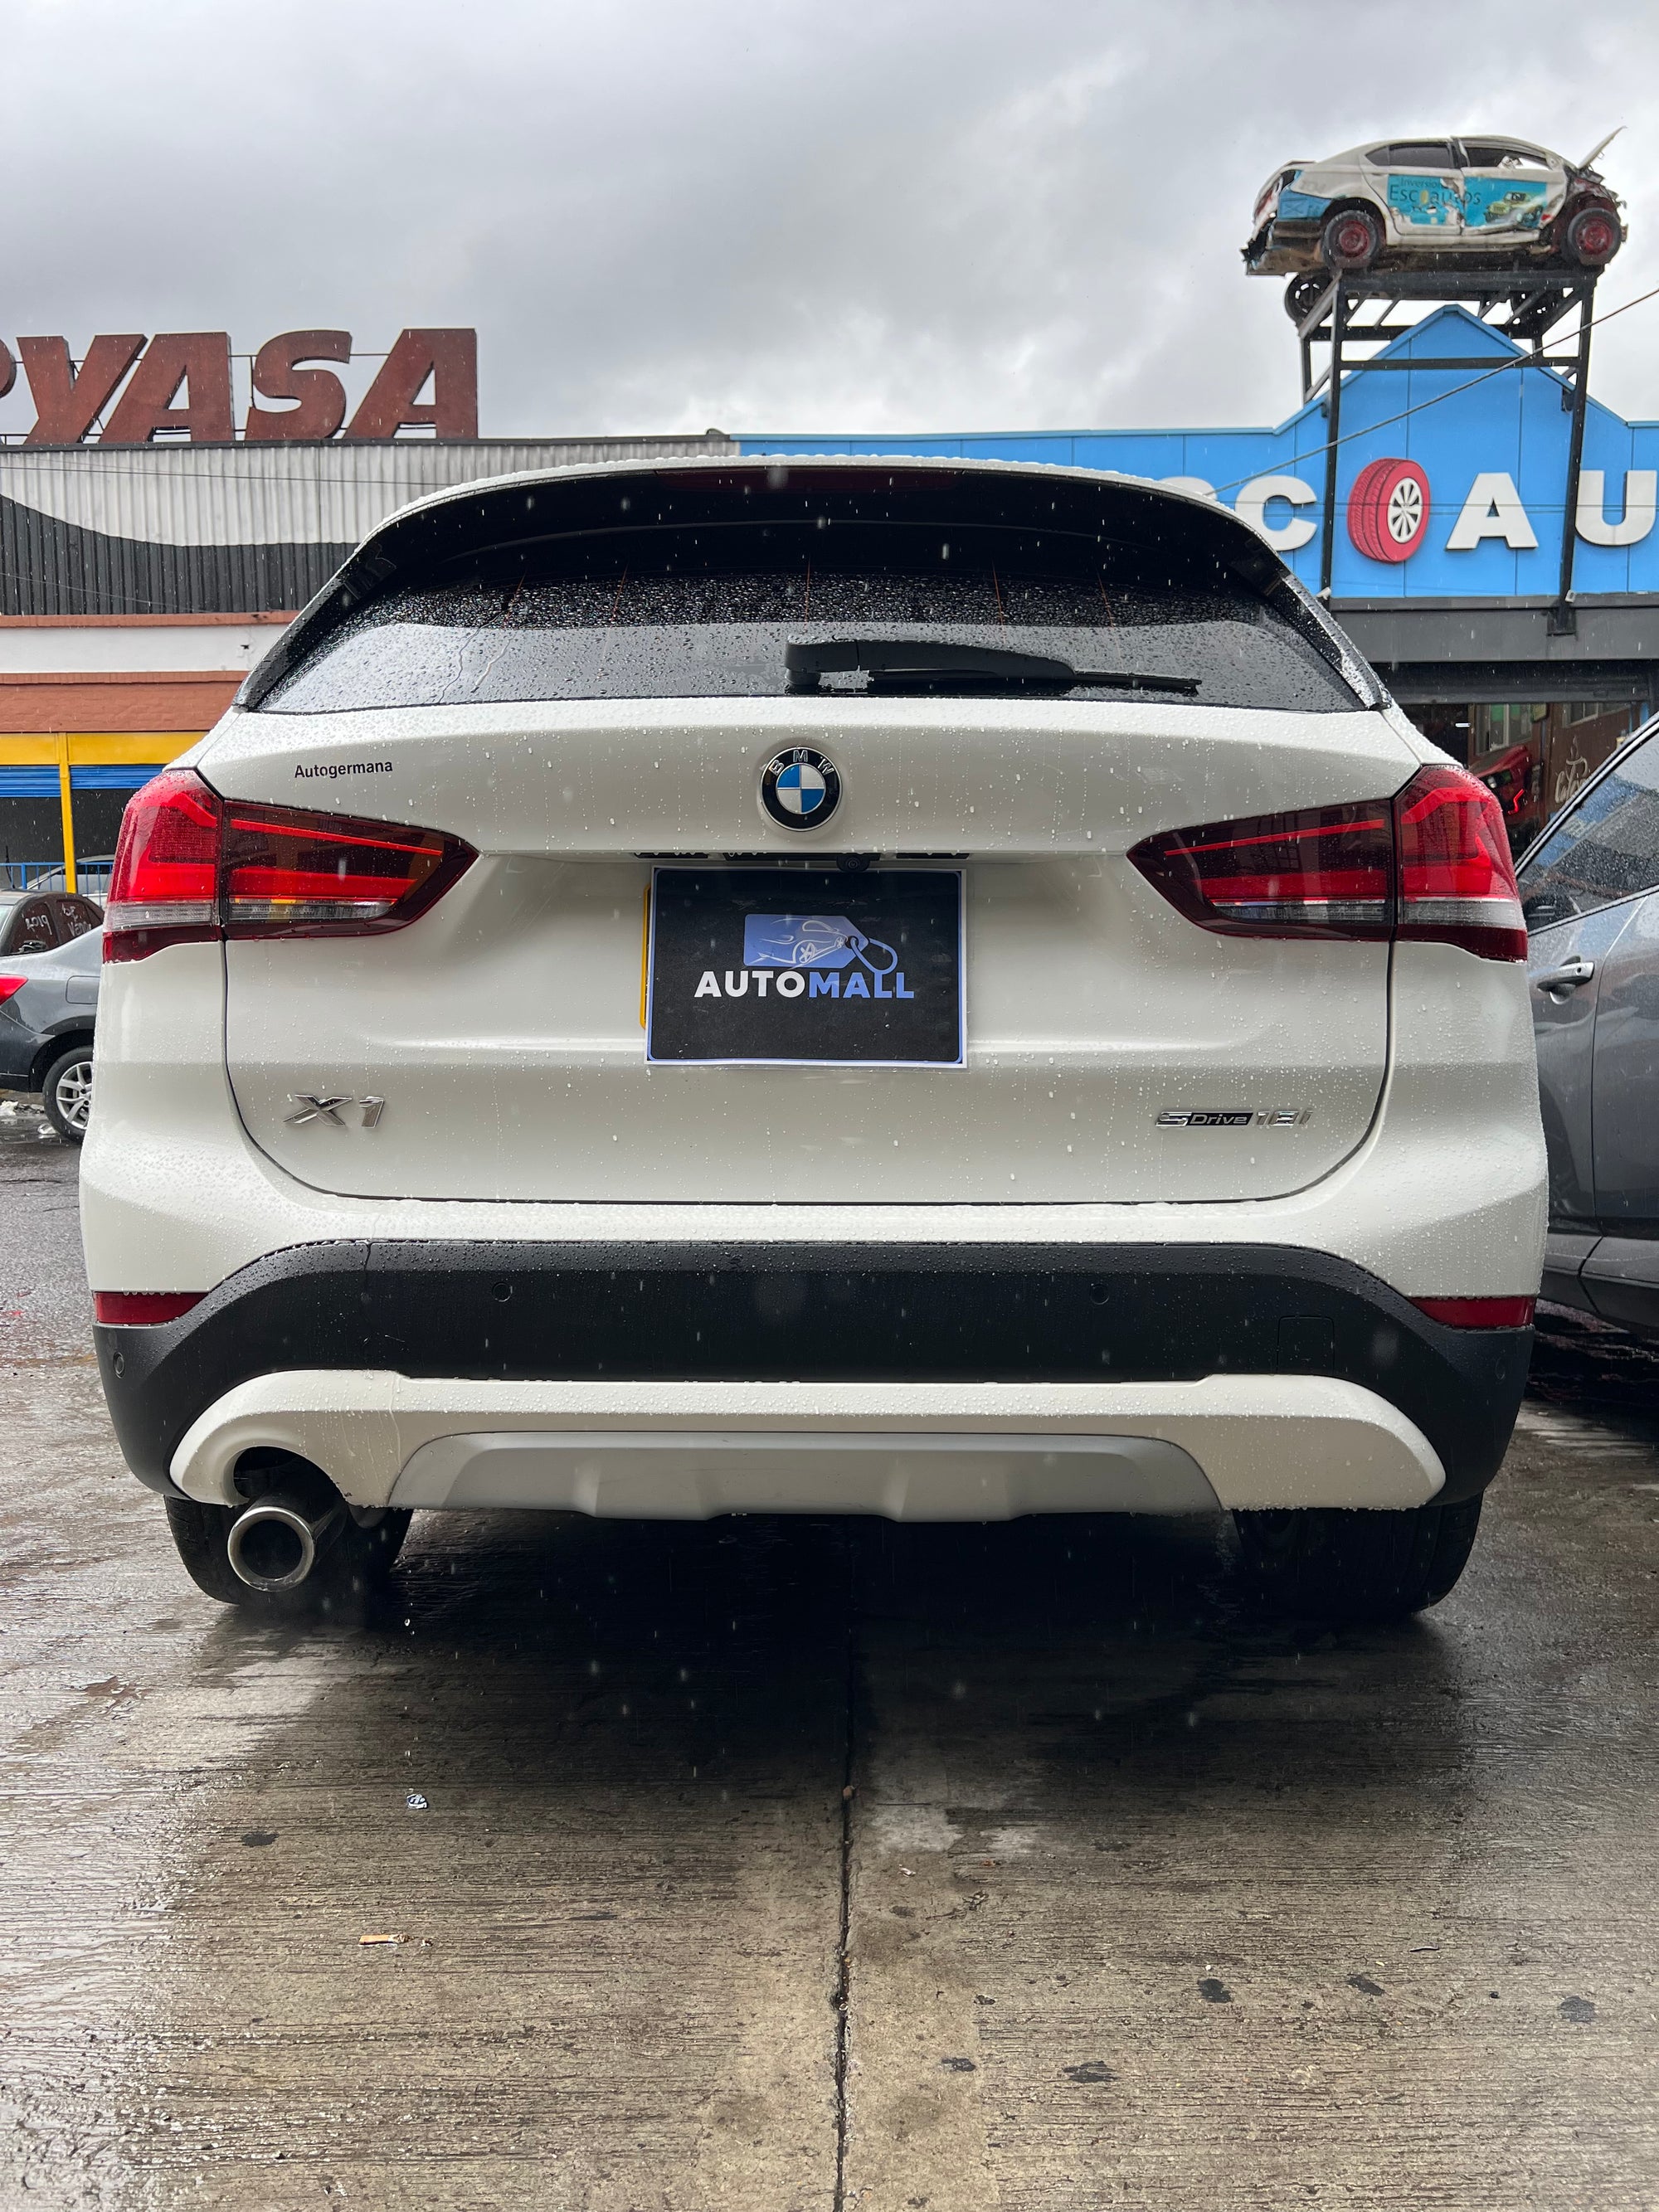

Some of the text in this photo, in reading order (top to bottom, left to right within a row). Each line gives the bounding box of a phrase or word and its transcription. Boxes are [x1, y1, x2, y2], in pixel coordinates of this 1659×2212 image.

[0, 328, 479, 444] YASA
[294, 761, 393, 779] Autogermana
[768, 750, 834, 776] BMW
[693, 970, 915, 999] AUTOMALL
[283, 1094, 384, 1129] X1
